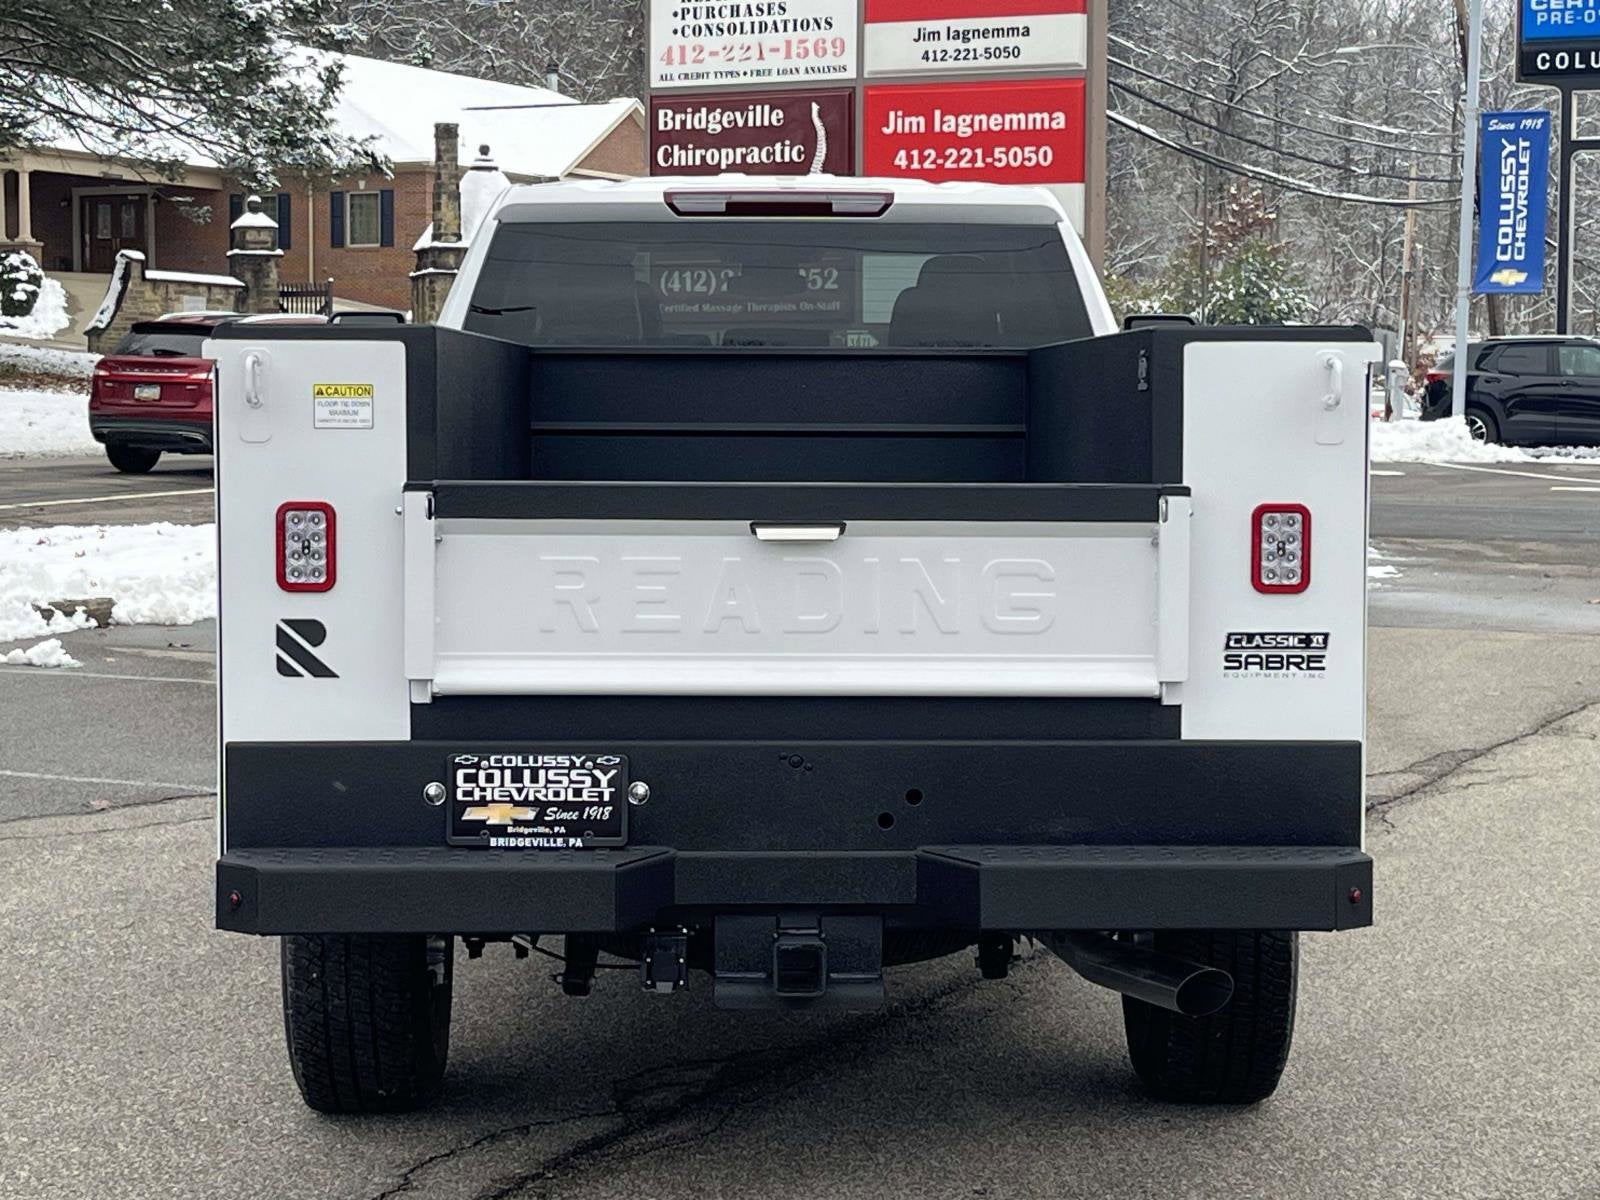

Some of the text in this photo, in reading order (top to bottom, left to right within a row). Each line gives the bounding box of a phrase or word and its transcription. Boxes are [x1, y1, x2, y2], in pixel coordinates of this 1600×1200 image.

[681, 2, 787, 20] PURCHASES
[1537, 9, 1600, 26] PRE-O
[681, 17, 833, 38] CONSOLIDATIONS
[913, 27, 941, 43] Jim
[660, 37, 846, 66] 412-221-1569
[921, 45, 1021, 62] 412-221-5050
[658, 64, 848, 82] ALL CREDIT TYPES FREE LOAN ANALYSIS
[658, 104, 784, 134] Bridgeville
[881, 110, 926, 135] Jim
[1520, 118, 1545, 130] 1918
[657, 140, 805, 170] Chiropractic
[894, 146, 1053, 169] 412-221-5050
[1496, 137, 1517, 262] COLUSSY
[1514, 137, 1531, 261] CHEVROLET
[325, 386, 371, 397] CAUTION
[538, 556, 1057, 635] READING
[1228, 635, 1306, 647] CLASSIC
[1223, 654, 1326, 671] SABRE
[1223, 672, 1298, 680] EQUIPMENT
[490, 755, 586, 767] COLUSSY
[456, 769, 618, 788] COLUSSY
[456, 788, 616, 802] CHEVROLET
[543, 806, 613, 820] Since 1918
[554, 826, 566, 834] PA
[489, 837, 583, 848] BRIDGEVILLE, PA
